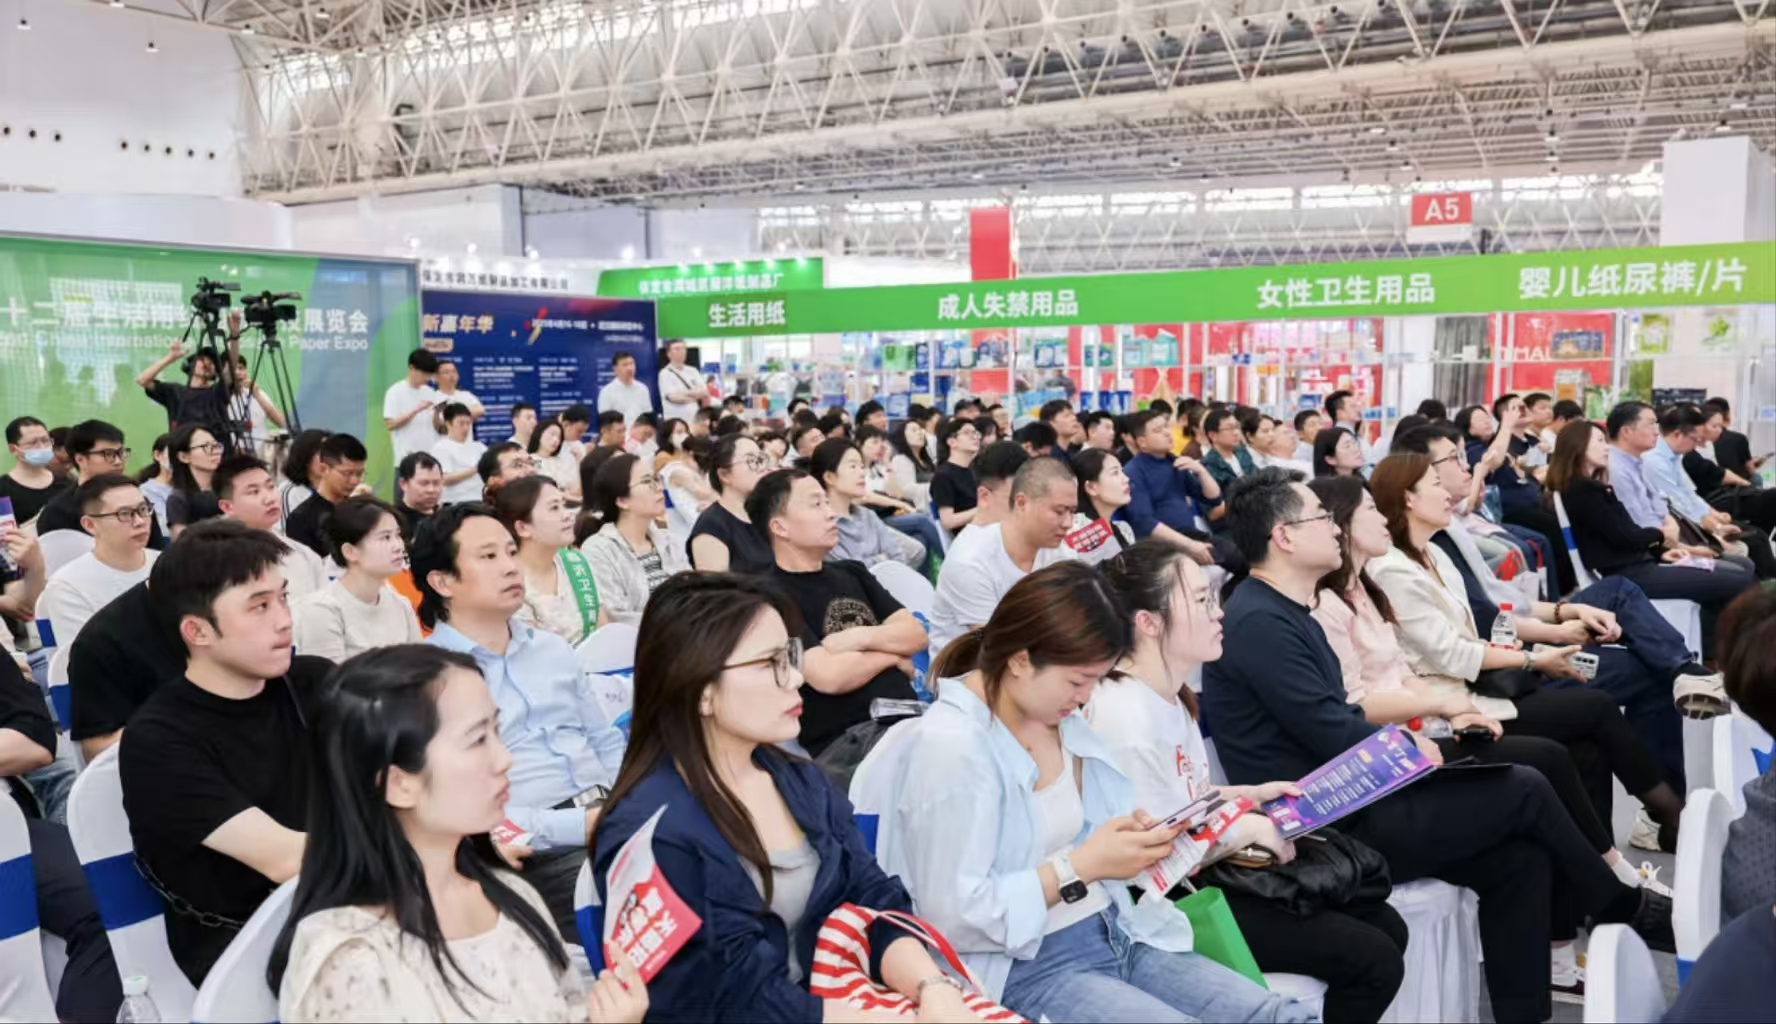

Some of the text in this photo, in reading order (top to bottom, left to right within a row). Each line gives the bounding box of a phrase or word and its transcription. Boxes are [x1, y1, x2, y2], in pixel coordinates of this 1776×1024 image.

[1424, 198, 1460, 221] A5
[1257, 274, 1436, 308] 女性卫生用品
[1518, 258, 1748, 299] 婴儿纸尿裤/片
[708, 300, 786, 327] 生活用纸
[938, 289, 1079, 320] 成人失禁用品
[289, 336, 330, 353] Paper
[334, 336, 368, 353] Expo
